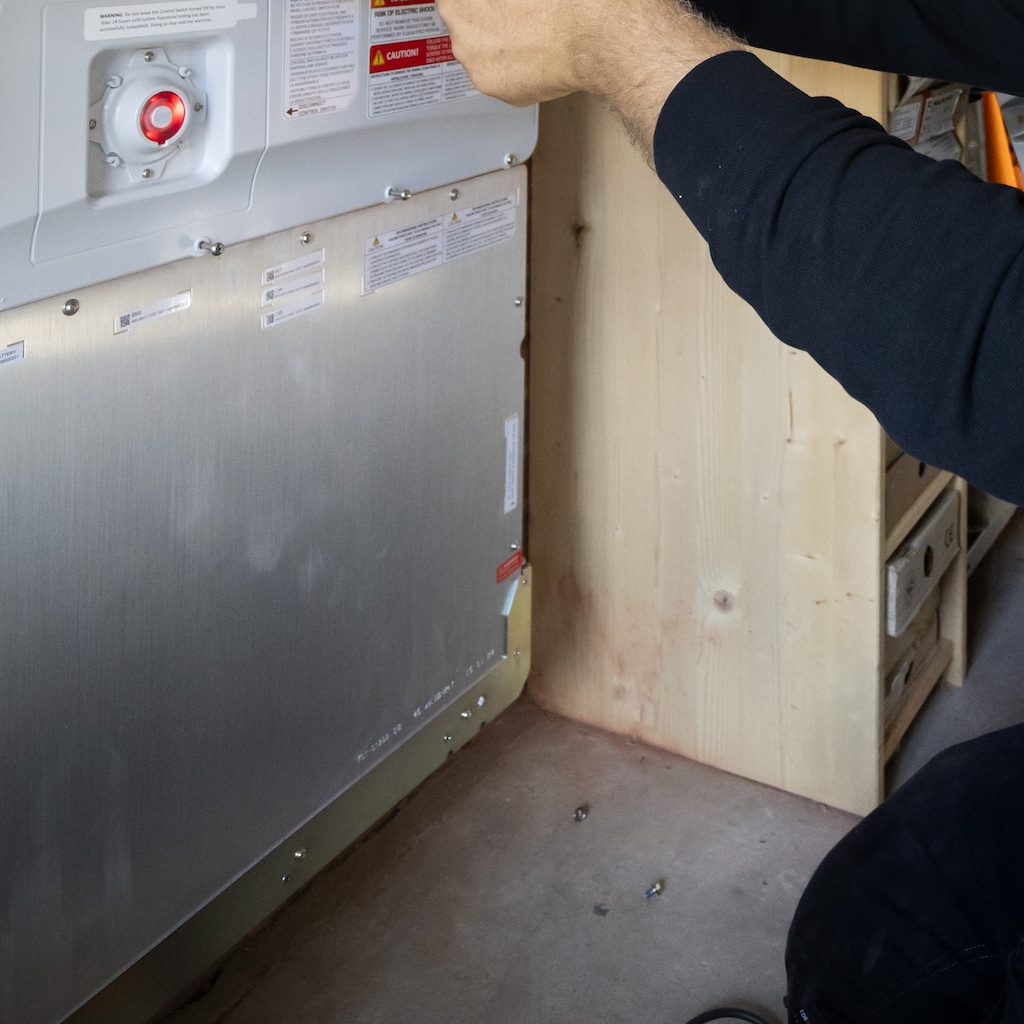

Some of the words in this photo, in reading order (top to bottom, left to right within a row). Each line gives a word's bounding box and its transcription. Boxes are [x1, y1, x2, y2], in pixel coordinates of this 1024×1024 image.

[387, 48, 419, 60] CAUTION!
[298, 108, 319, 117] CONTROL
[320, 104, 337, 112] SWITCH
[299, 100, 326, 110] DISCONNECT
